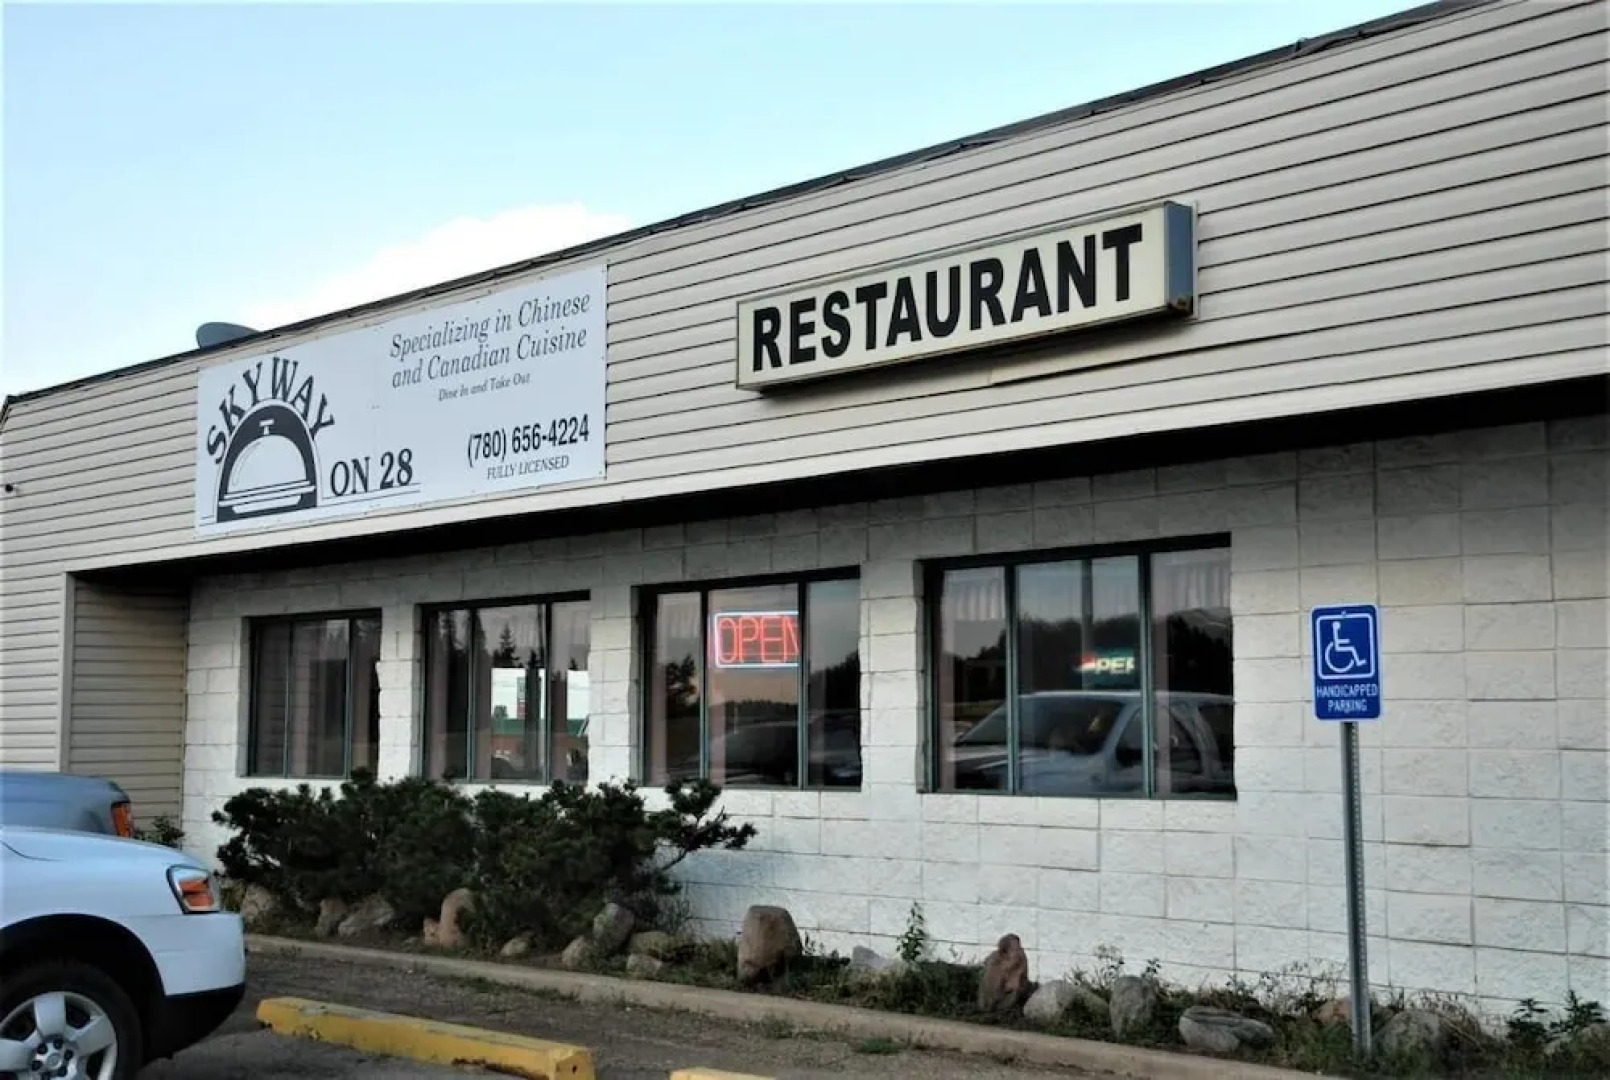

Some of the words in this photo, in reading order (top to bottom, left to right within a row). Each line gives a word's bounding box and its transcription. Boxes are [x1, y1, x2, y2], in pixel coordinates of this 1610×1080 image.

[753, 223, 1143, 372] RESTAURANT
[390, 316, 490, 362] Specializing
[495, 309, 512, 334] in
[518, 294, 590, 327] Chinese
[392, 358, 423, 388] and
[428, 343, 510, 380] Canadian
[517, 326, 587, 360] Cuisine
[207, 357, 335, 464] SKYWAY
[438, 388, 458, 401] Dine
[470, 379, 488, 395] and
[489, 375, 511, 391] Take
[513, 373, 531, 386] Out
[467, 428, 506, 468] (780)
[512, 414, 589, 454] 656-4224
[330, 457, 370, 496] ON
[380, 448, 413, 489] 28
[487, 463, 517, 480] FULLY
[519, 455, 569, 475] LICENSED
[1316, 684, 1378, 698] HANDICAPPED
[1327, 699, 1368, 713] PARKING
